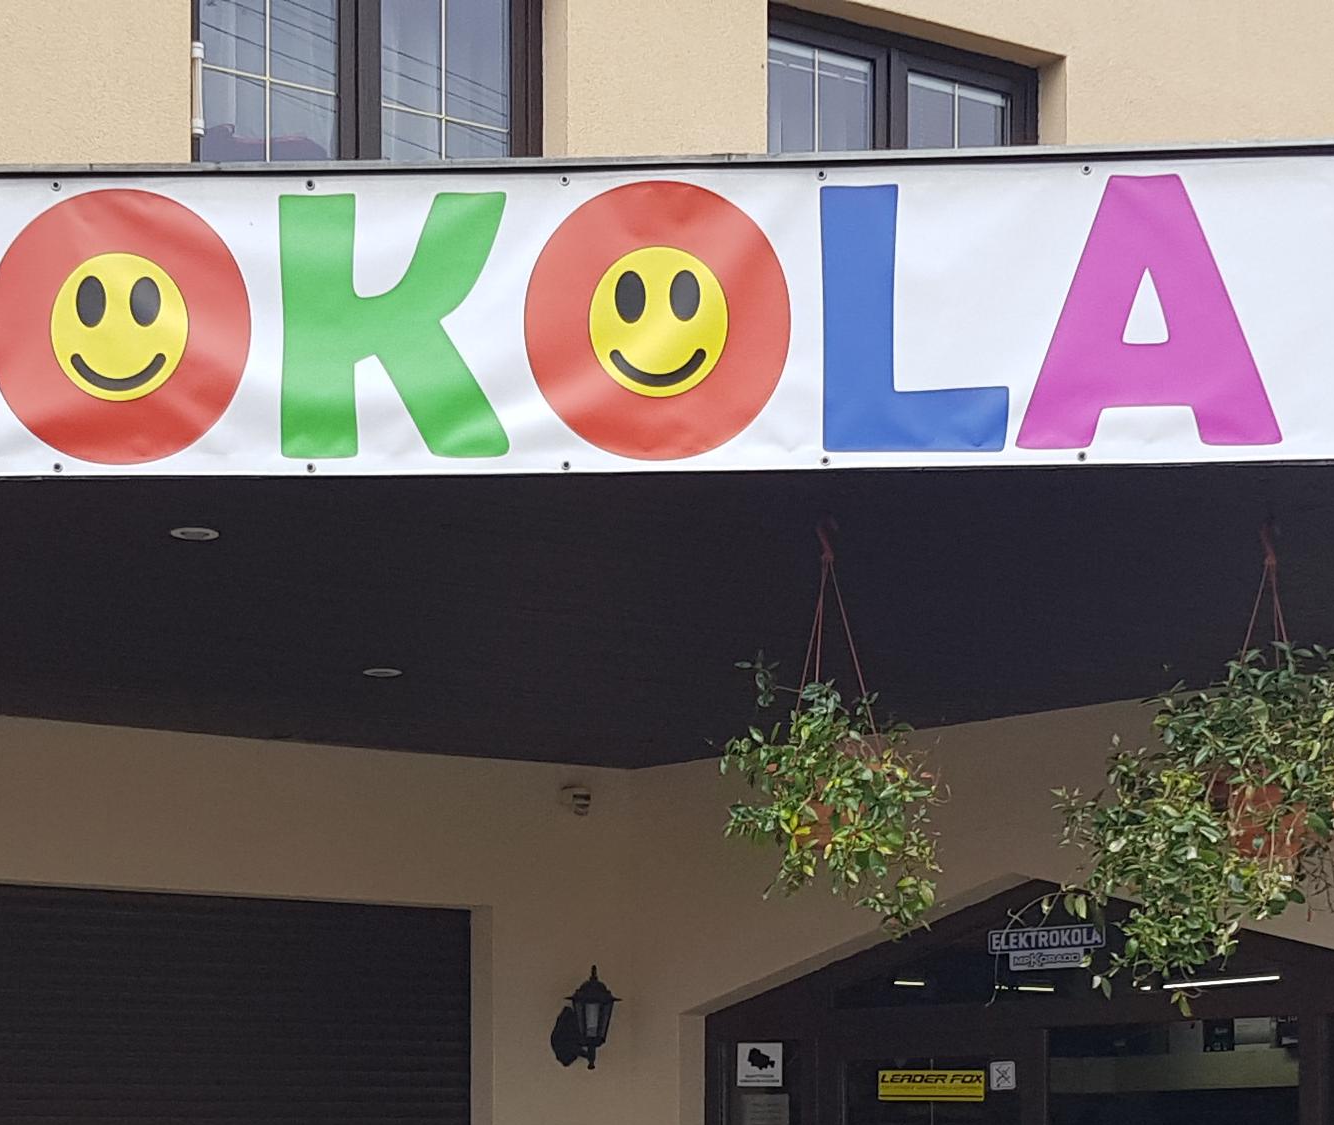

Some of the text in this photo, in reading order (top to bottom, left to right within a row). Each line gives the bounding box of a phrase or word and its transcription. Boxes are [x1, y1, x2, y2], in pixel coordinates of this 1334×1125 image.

[991, 927, 1103, 950] ELEKTROKOLA
[880, 1073, 983, 1084] LEADER FOX
